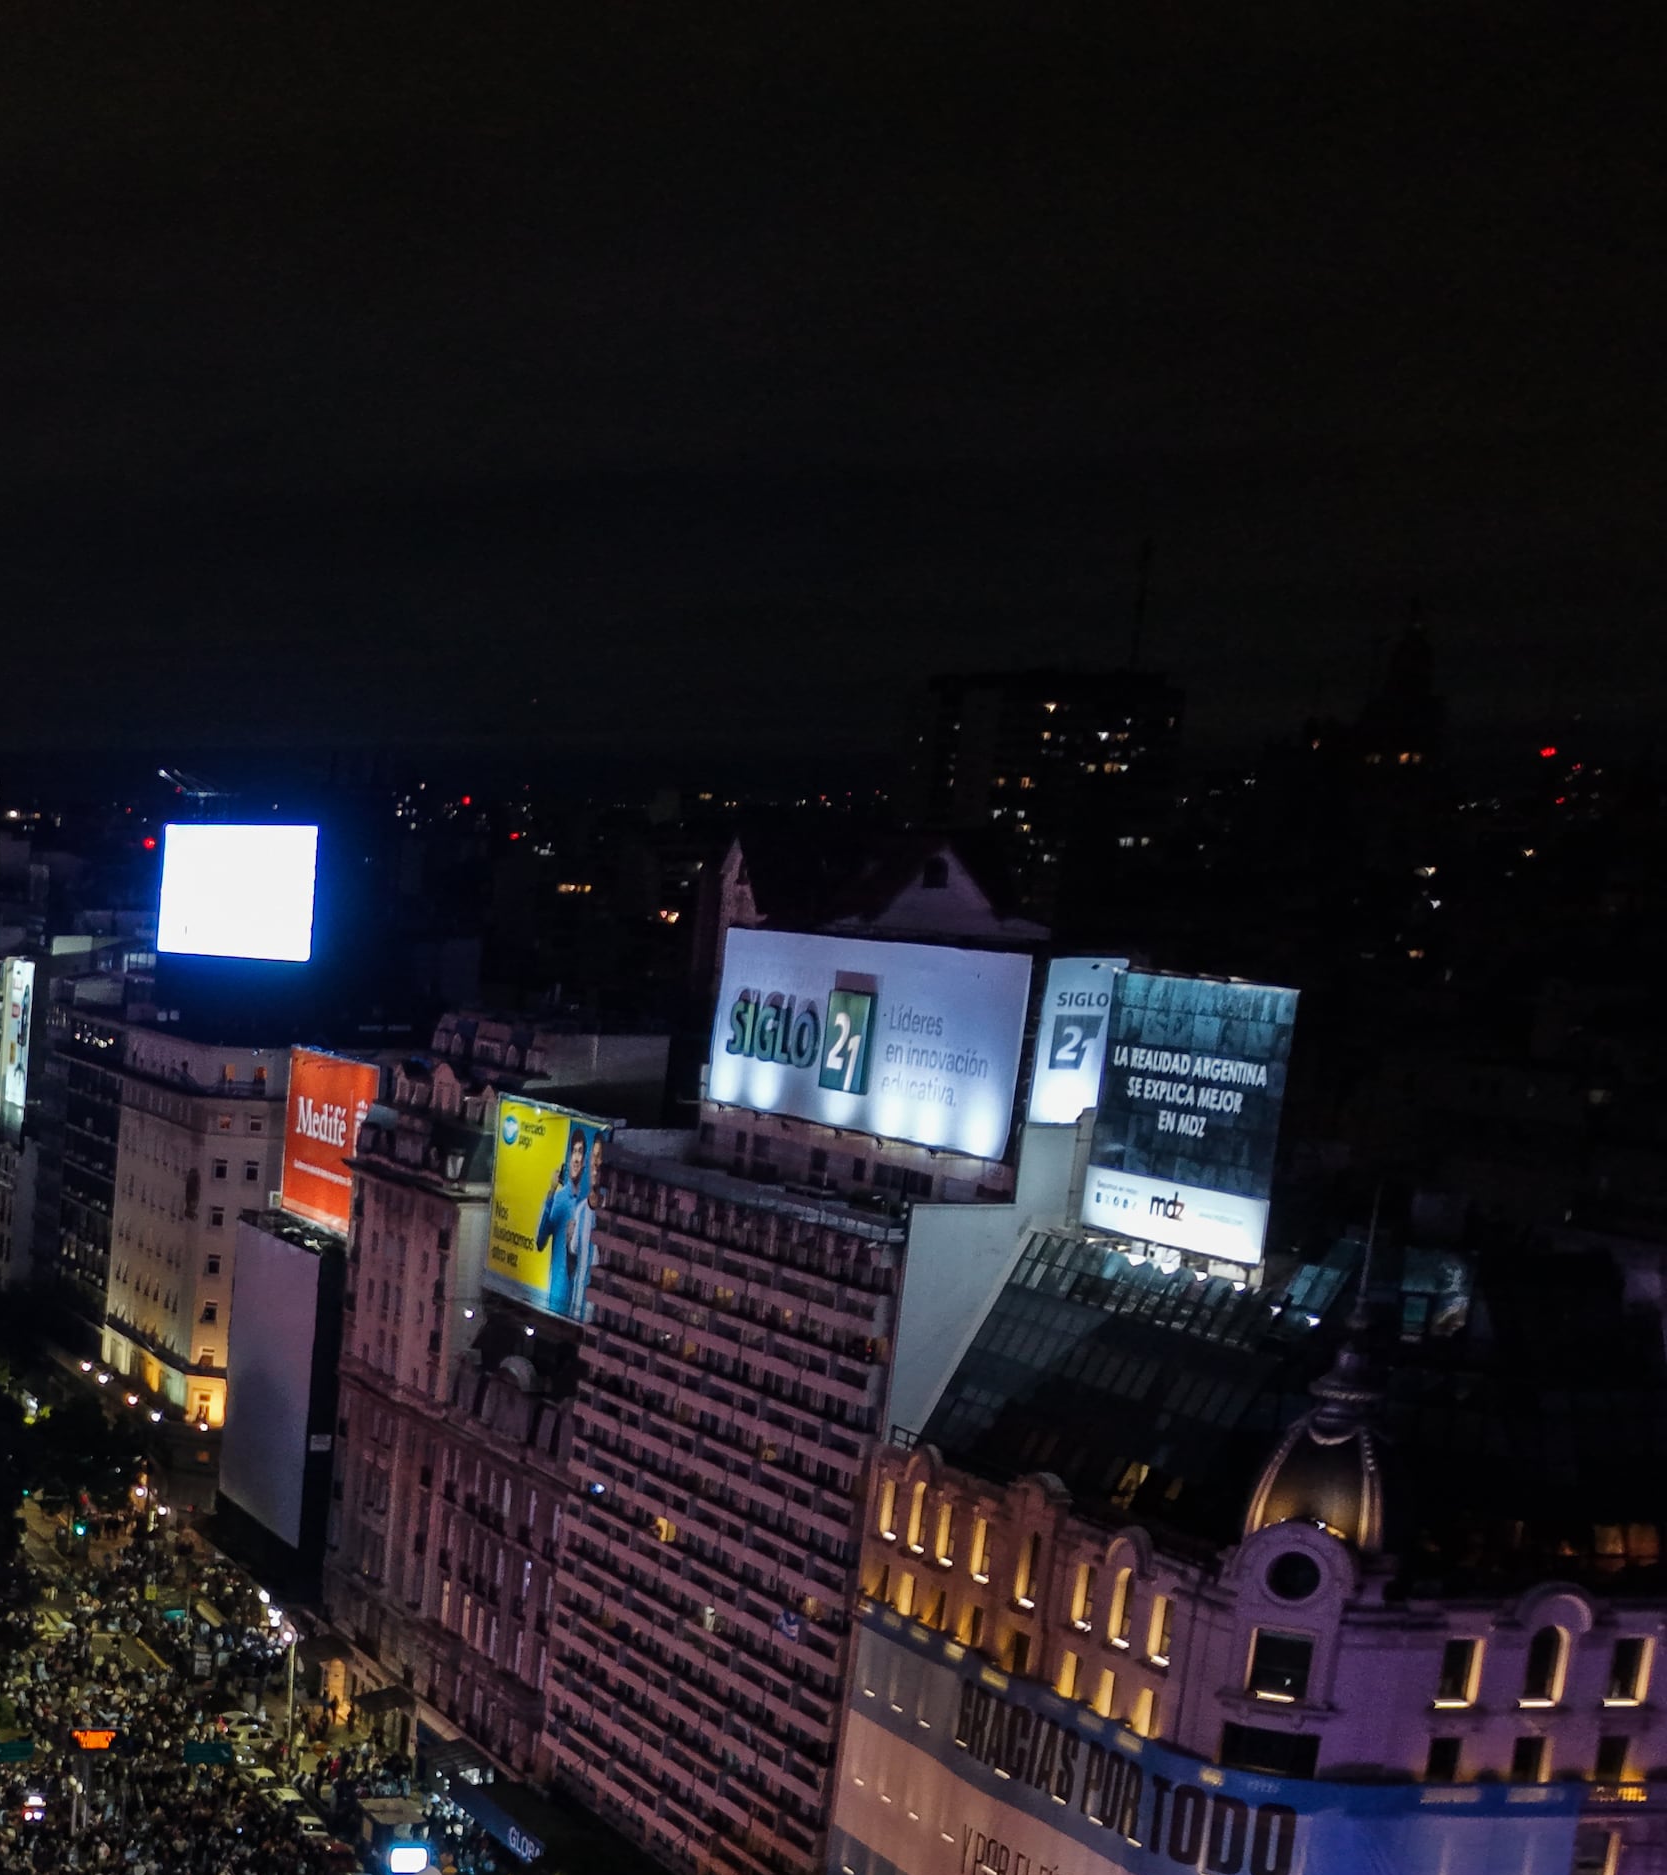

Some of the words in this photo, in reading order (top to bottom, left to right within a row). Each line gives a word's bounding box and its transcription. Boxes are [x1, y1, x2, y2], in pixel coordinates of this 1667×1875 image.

[1057, 992, 1109, 1008] SIGLO
[889, 1005, 944, 1036] Líderes
[726, 992, 820, 1068] SIGLO
[826, 1012, 862, 1091] 21
[1055, 1026, 1094, 1065] 21
[885, 1044, 905, 1062] en
[906, 1046, 989, 1079] innovación
[1114, 1046, 1129, 1066] LA
[1130, 1048, 1192, 1077] REALIDAD
[1191, 1056, 1268, 1088] ARGENTINA
[1127, 1076, 1142, 1097] SE
[1144, 1079, 1196, 1107] EXPLICA
[1197, 1089, 1244, 1114] MEJOR
[296, 1096, 347, 1148] Medifé
[1158, 1110, 1177, 1133] EN
[1178, 1115, 1207, 1138] MDZ
[495, 1201, 509, 1220] Nos
[1150, 1192, 1185, 1221] mdz
[955, 1679, 1080, 1805] GRACIAS
[1082, 1741, 1144, 1844] POR
[960, 1823, 973, 1875] Y
